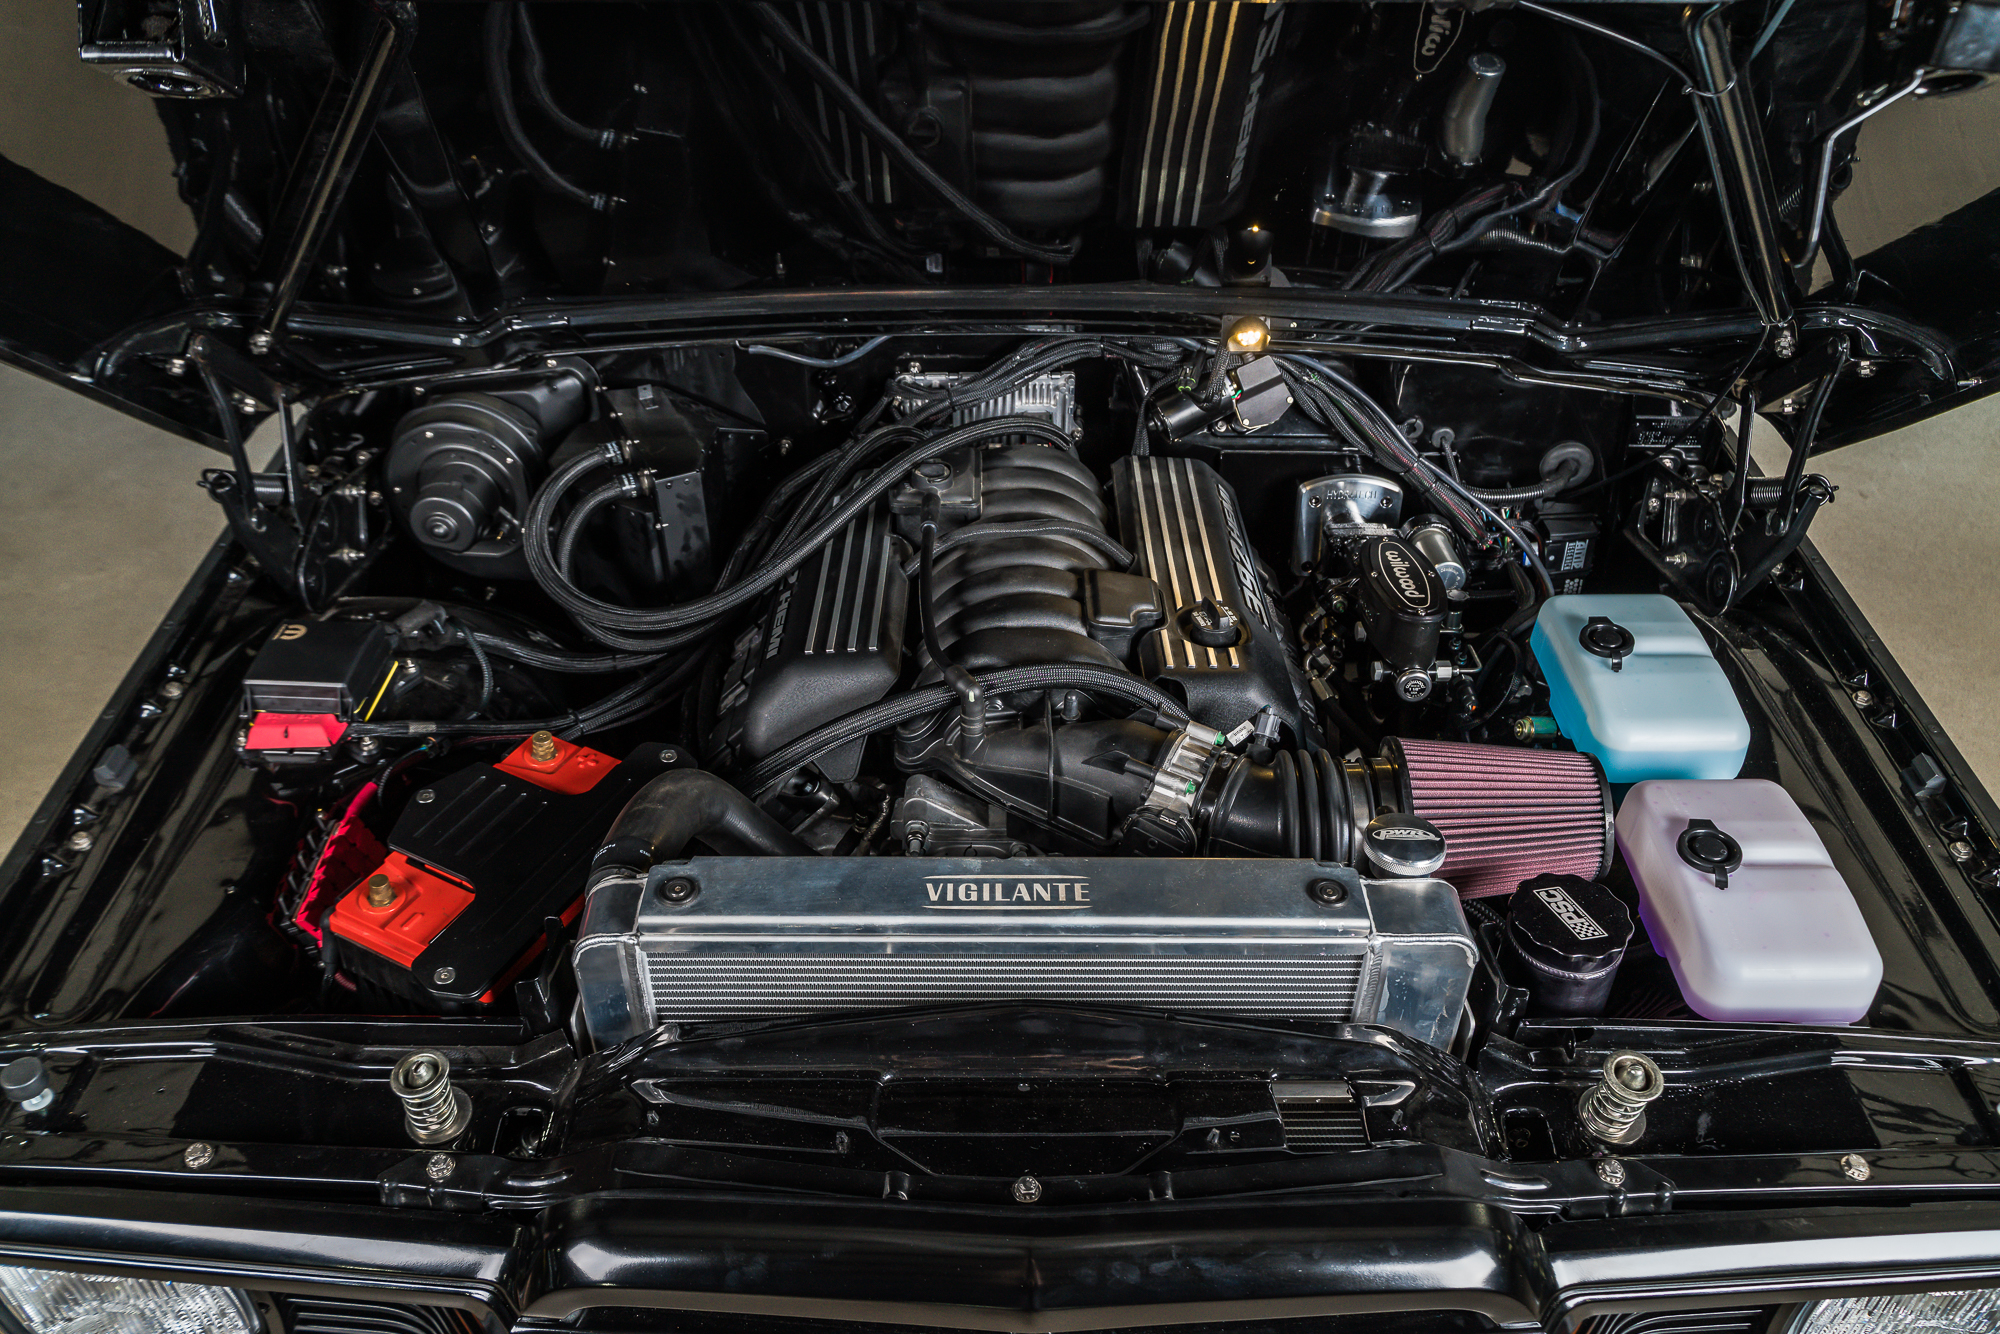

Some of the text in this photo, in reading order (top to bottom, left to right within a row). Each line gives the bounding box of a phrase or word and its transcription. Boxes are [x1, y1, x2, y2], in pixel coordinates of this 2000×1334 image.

[1215, 483, 1272, 634] 392 HEMI
[1385, 550, 1426, 598] wilwood
[766, 589, 792, 660] HEMI
[926, 883, 1091, 901] VIGILANTE
[1539, 889, 1587, 924] PSC
